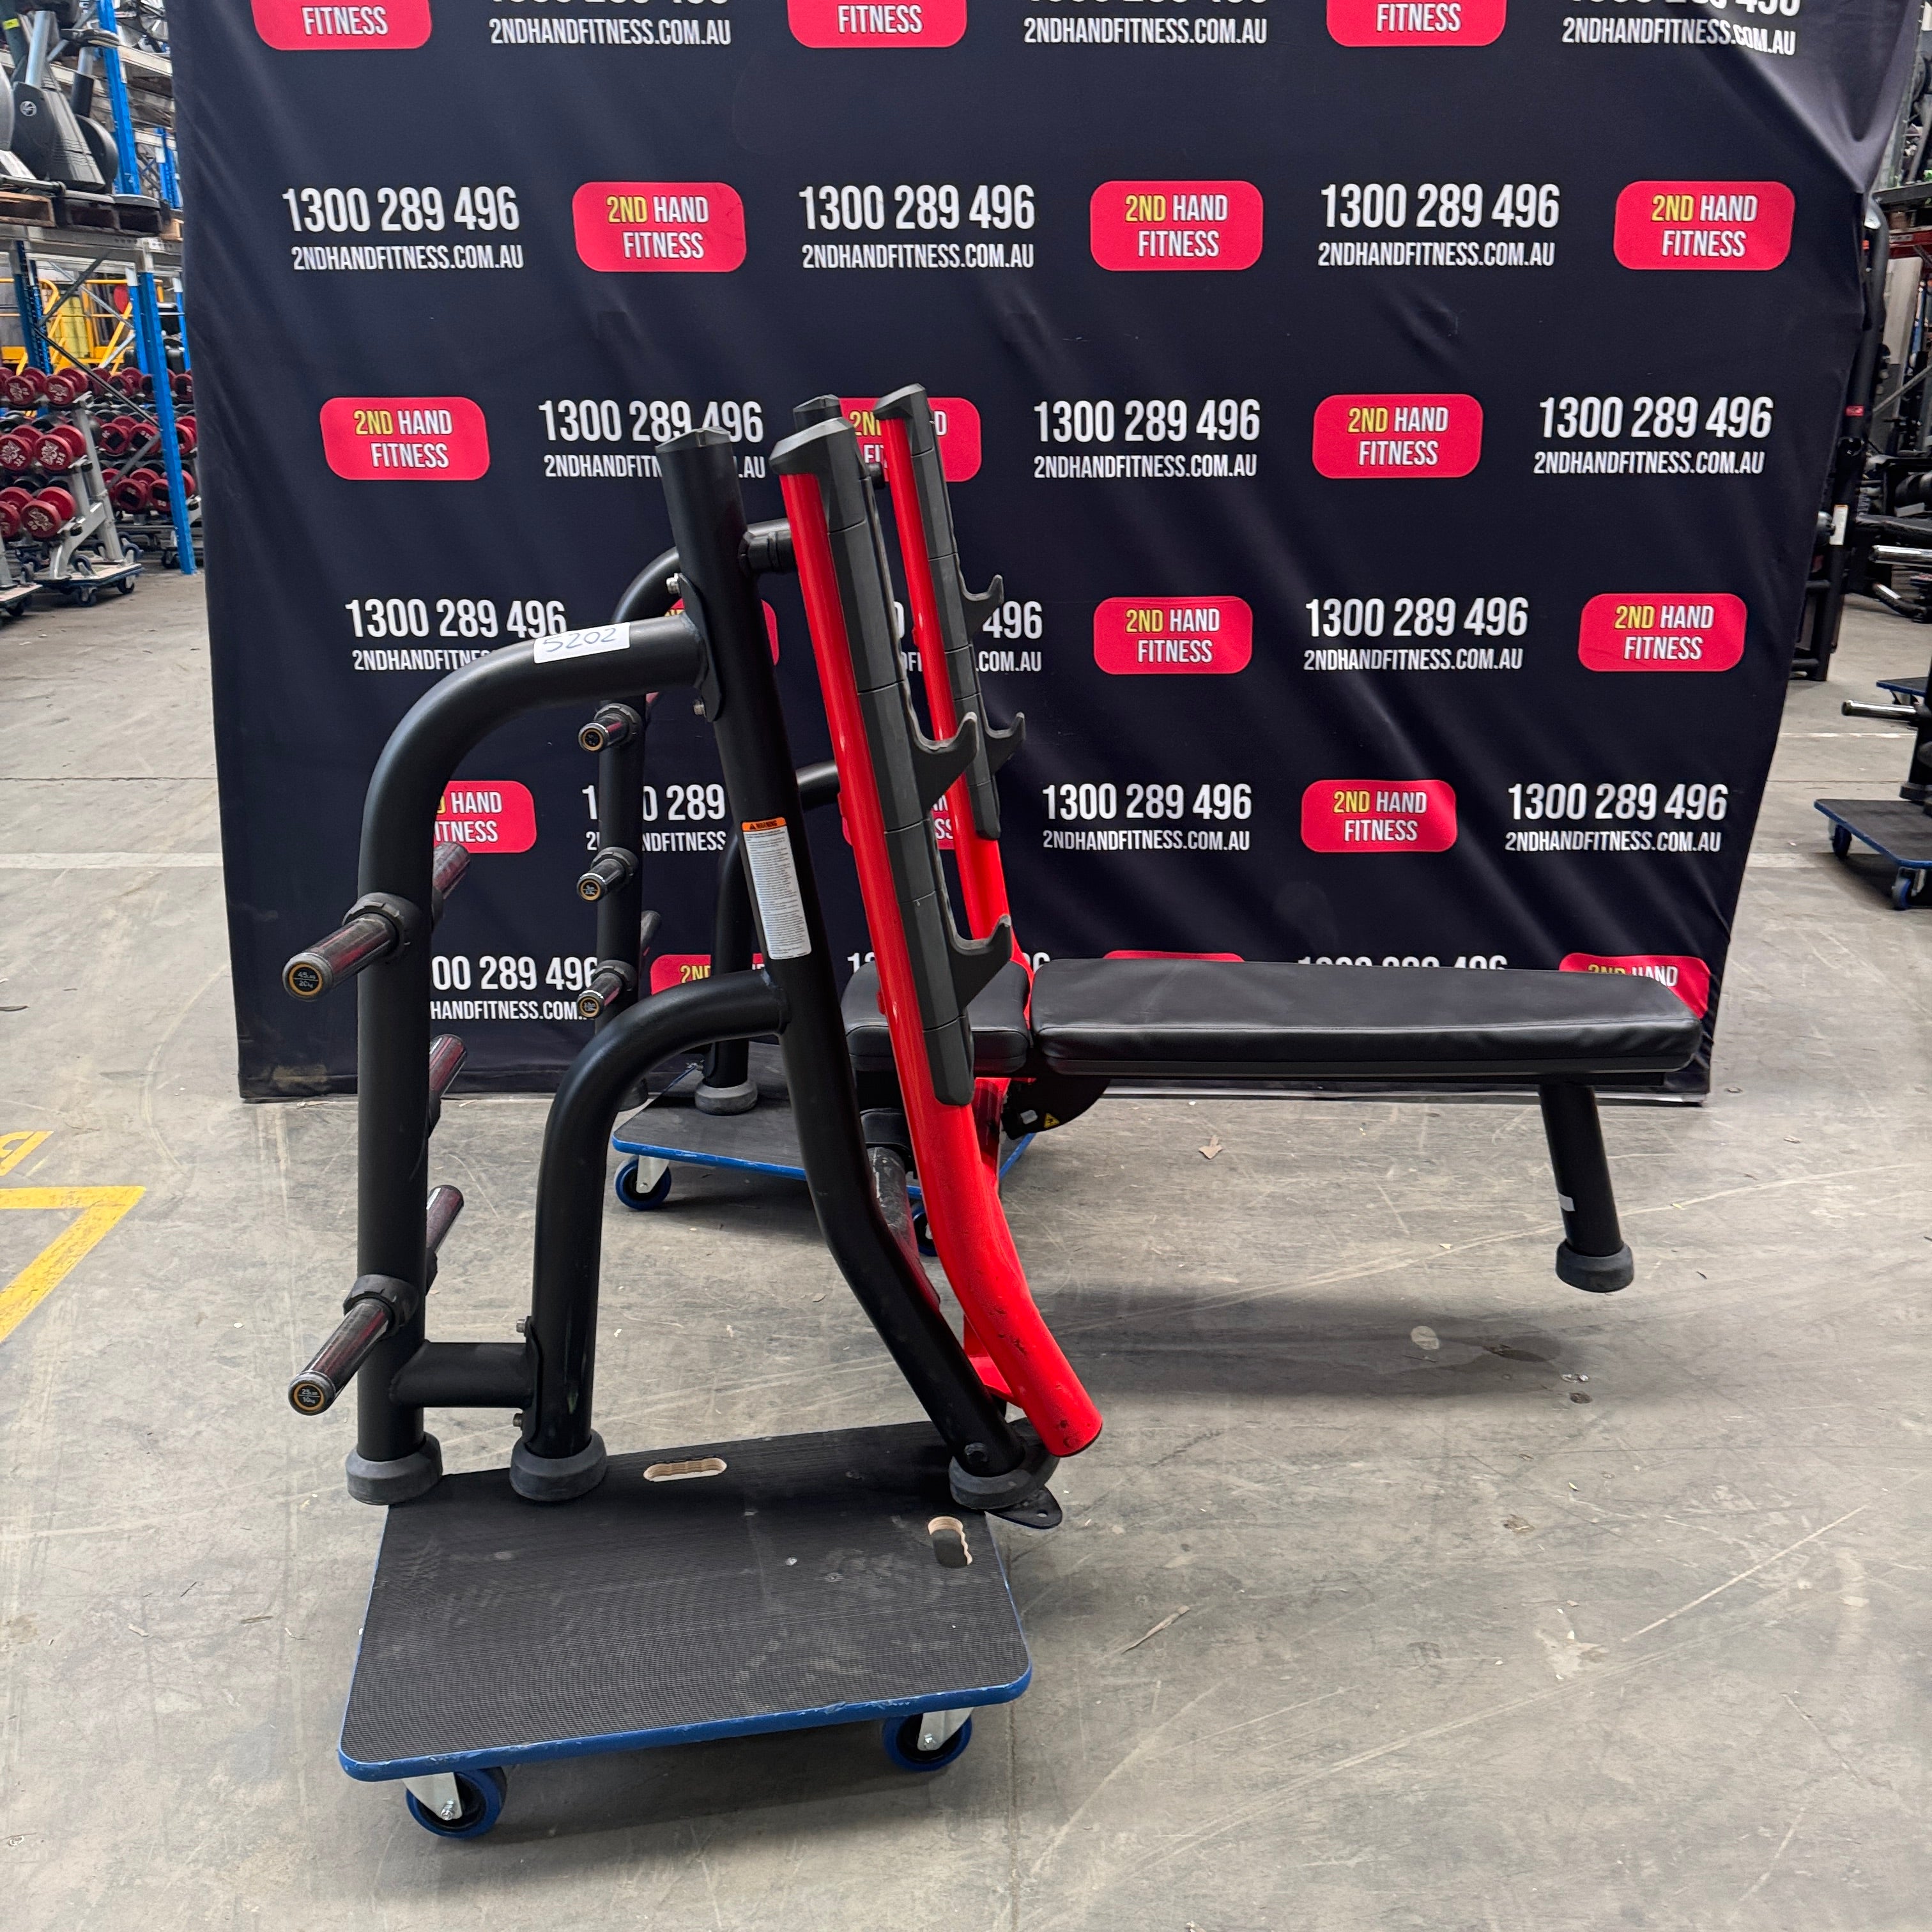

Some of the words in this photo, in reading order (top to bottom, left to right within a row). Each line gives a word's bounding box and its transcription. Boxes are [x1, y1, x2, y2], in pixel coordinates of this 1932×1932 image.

[302, 6, 388, 35] FITNESS
[838, 4, 923, 33] FITNESS
[1023, 17, 1267, 44] 2NDHANDFITNESS.COM.AU
[1376, 3, 1462, 32] FITNESS
[489, 18, 732, 45] 2NDHANDFITNESS.COM.AU
[1561, 16, 1797, 56] 2NDHANDFITNESS.COM.AU
[282, 187, 371, 233] 1300
[377, 187, 445, 231] 289
[454, 186, 520, 231] 496
[606, 196, 648, 223] 2ND
[653, 196, 709, 223] HAND
[799, 185, 885, 230] 1300
[894, 184, 960, 230] 289
[969, 184, 1035, 229] 496
[1126, 195, 1166, 222] 2ND
[1172, 194, 1228, 221] HAND
[1321, 183, 1407, 228] 1300
[1416, 183, 1483, 228] 289
[1491, 183, 1560, 228] 496
[1652, 195, 1694, 221] 2ND
[1699, 195, 1758, 222] HAND
[291, 244, 524, 270] 2NDHANDFITNESS.COM.AU
[623, 231, 705, 259] FITNESS
[801, 243, 1034, 268] 2NDHANDFITNESS.COM.AU
[1138, 230, 1220, 257] FITNESS
[1317, 241, 1555, 266] 2NDHANDFITNESS.COM.AU
[1662, 230, 1747, 257] FITNESS
[353, 410, 394, 435] 2ND
[397, 410, 453, 435] HAND
[538, 399, 622, 441] 1300
[629, 400, 693, 441] 289
[1034, 400, 1115, 443] 1300
[1124, 399, 1187, 441] 289
[1195, 399, 1261, 441] 496
[1348, 408, 1388, 433] 2ND
[1394, 406, 1448, 432] HAND
[1539, 396, 1623, 438] 1300
[1630, 396, 1698, 438] 289
[1705, 396, 1774, 438] 496
[371, 443, 449, 468] FITNESS
[1034, 454, 1257, 479] 2NDHANDFITNESS.COM.AU
[1359, 440, 1439, 466] FITNESS
[1533, 450, 1765, 474] 2NDHANDFITNESS.COM.AU
[344, 598, 429, 638] 1300
[436, 599, 498, 638] 289
[506, 600, 567, 638] 496
[981, 601, 1043, 639] 496
[1126, 609, 1163, 632] 2ND
[1170, 608, 1220, 632] HAND
[1305, 598, 1384, 638] 1300
[1393, 597, 1456, 637] 289
[1463, 597, 1529, 636] 496
[1614, 605, 1655, 629] 2ND
[1660, 605, 1714, 629] HAND
[542, 627, 617, 653] 5202
[1138, 640, 1213, 663] FITNESS
[1624, 636, 1703, 660] FITNESS
[1303, 648, 1523, 671] 2NDHANDFITNESS.COM.AU
[450, 792, 503, 814] HAND
[581, 785, 659, 822] 10
[666, 783, 725, 821] 289
[1042, 783, 1117, 820] 1300
[1126, 783, 1184, 820] 289
[1192, 783, 1252, 820] 496
[1333, 791, 1370, 813] 2ND
[1376, 791, 1427, 813] HAND
[1508, 783, 1587, 820] 1300
[1595, 783, 1657, 820] 289
[1664, 783, 1729, 820] 496
[434, 820, 498, 843] ITNESS
[1043, 829, 1250, 851] 2NDHANDFITNESS.COM.AU
[1344, 819, 1418, 841] FITNESS
[1505, 830, 1721, 852] 2NDHANDFITNESS.COM.AU
[431, 955, 471, 990] 00
[479, 955, 537, 990] 289
